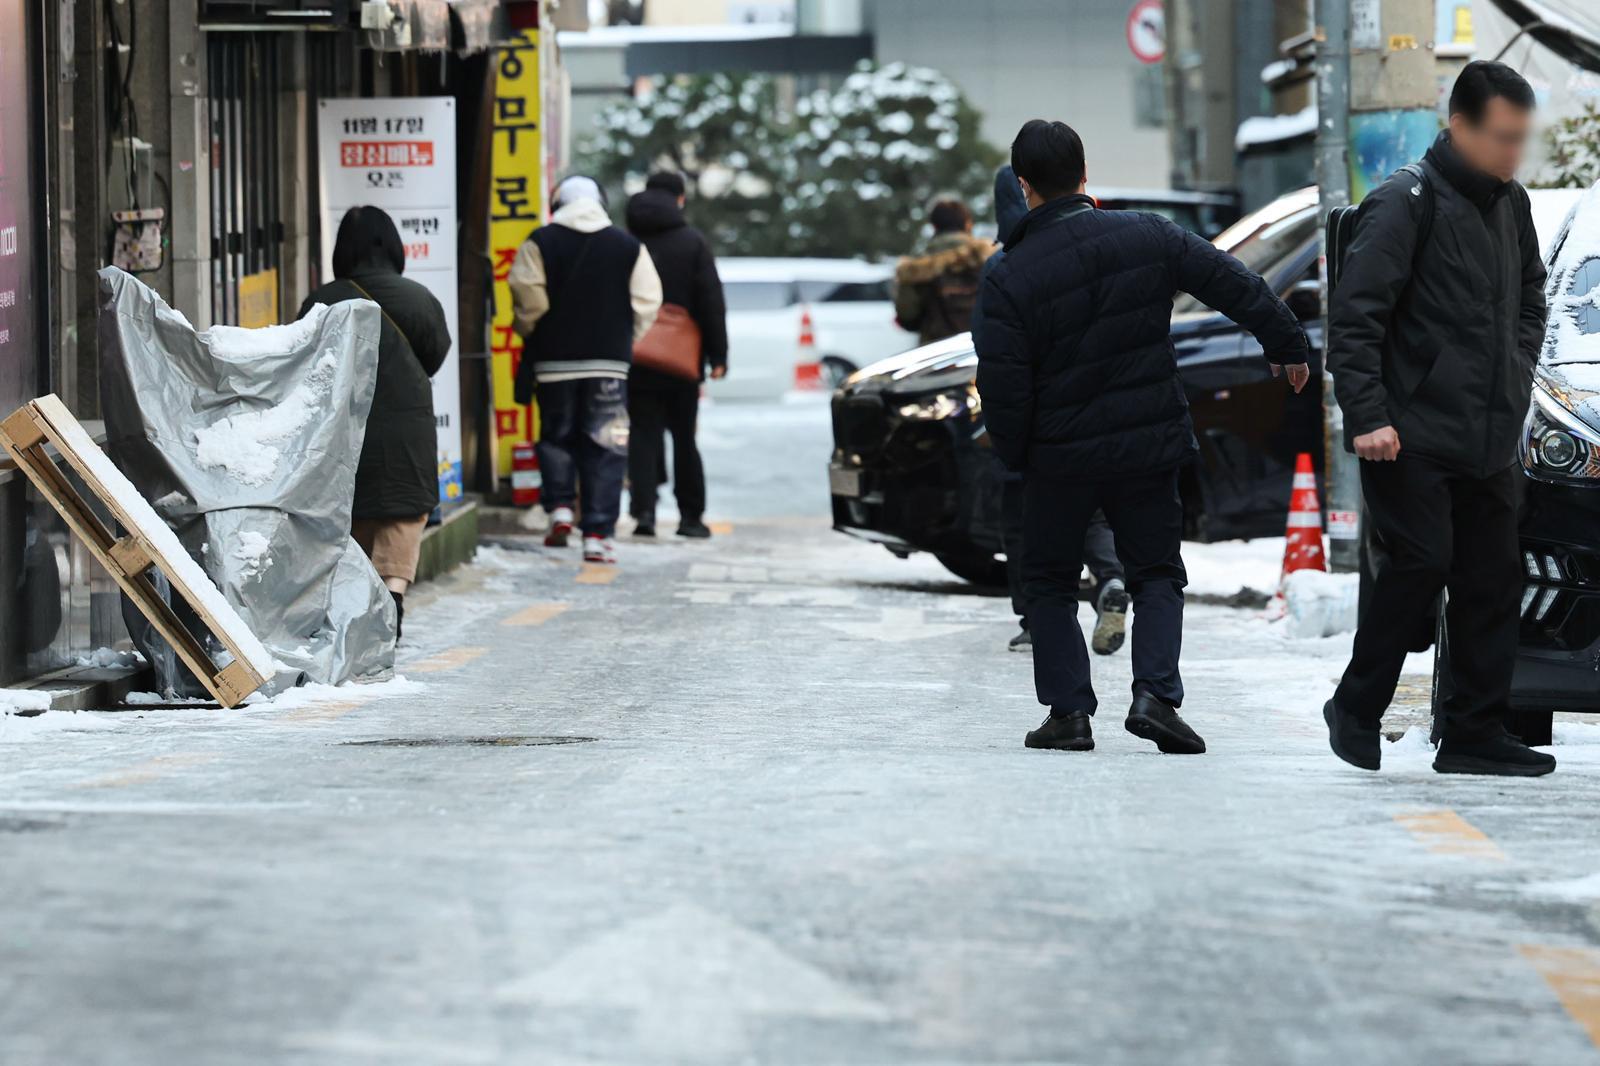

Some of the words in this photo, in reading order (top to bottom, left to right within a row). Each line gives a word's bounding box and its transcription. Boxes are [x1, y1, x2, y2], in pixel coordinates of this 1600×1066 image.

[343, 117, 377, 134] 11월
[385, 117, 423, 134] 17일
[343, 143, 432, 166] 점심메뉴
